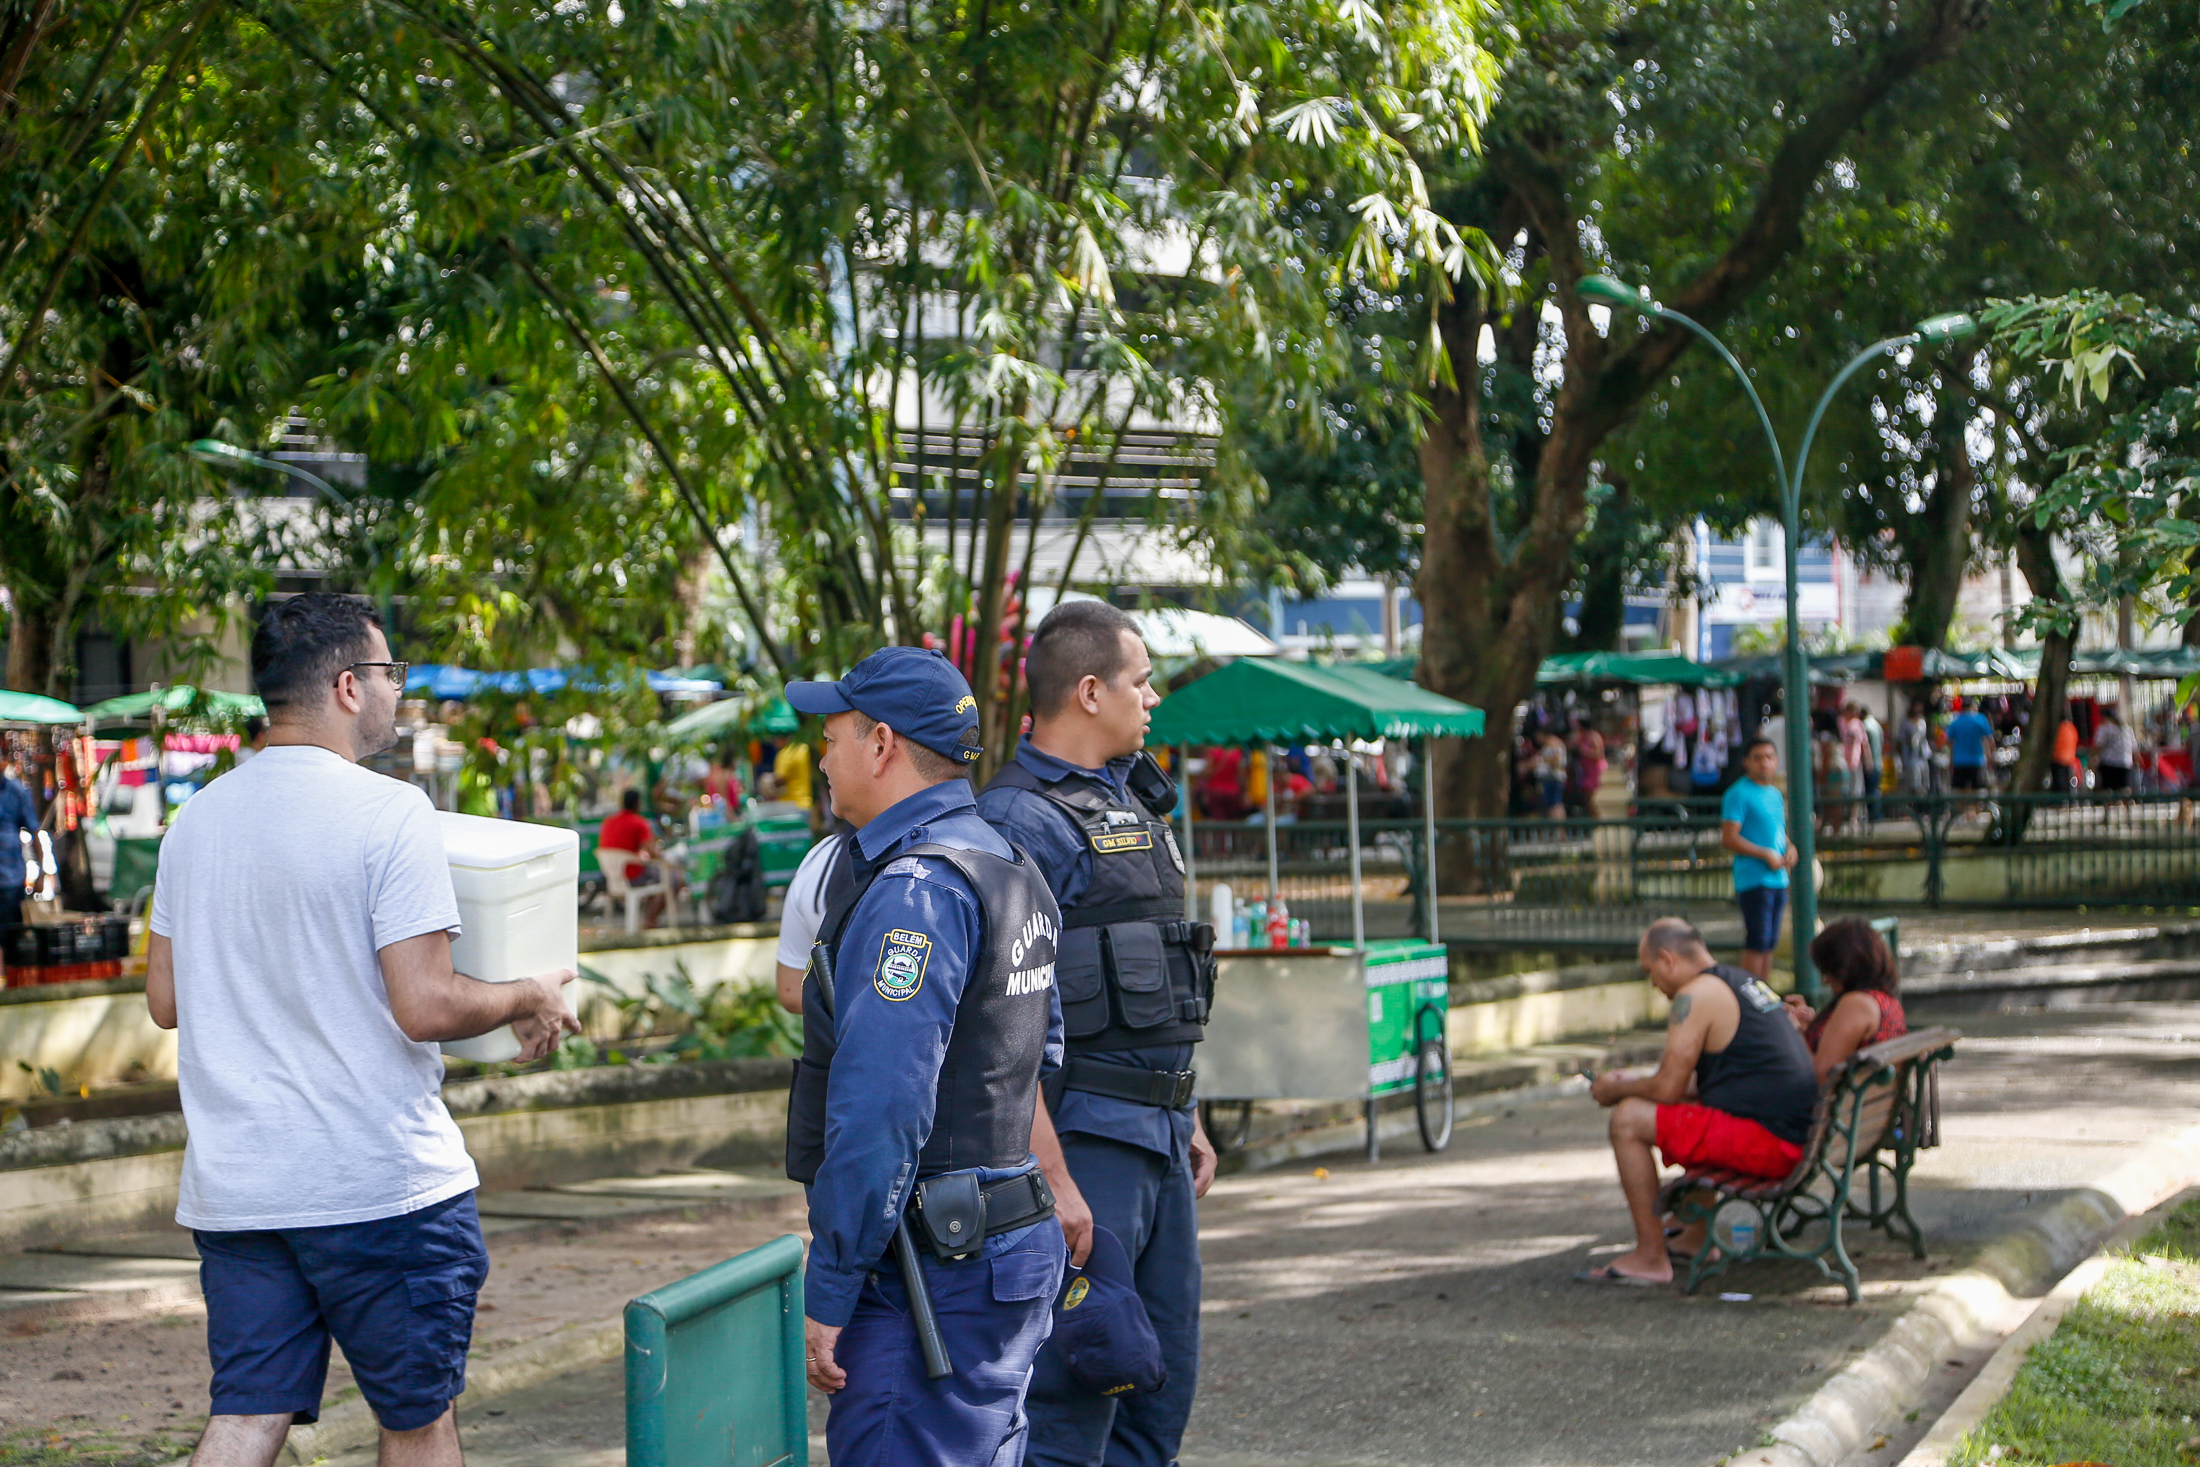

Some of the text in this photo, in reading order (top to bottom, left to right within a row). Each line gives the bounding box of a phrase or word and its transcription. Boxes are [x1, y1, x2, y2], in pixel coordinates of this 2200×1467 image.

[1102, 838, 1117, 848] GM
[893, 932, 923, 945] BELÉM
[1011, 910, 1058, 968] GUARDA
[887, 945, 923, 963] GUARDA
[877, 979, 915, 997] MUNICIPAL
